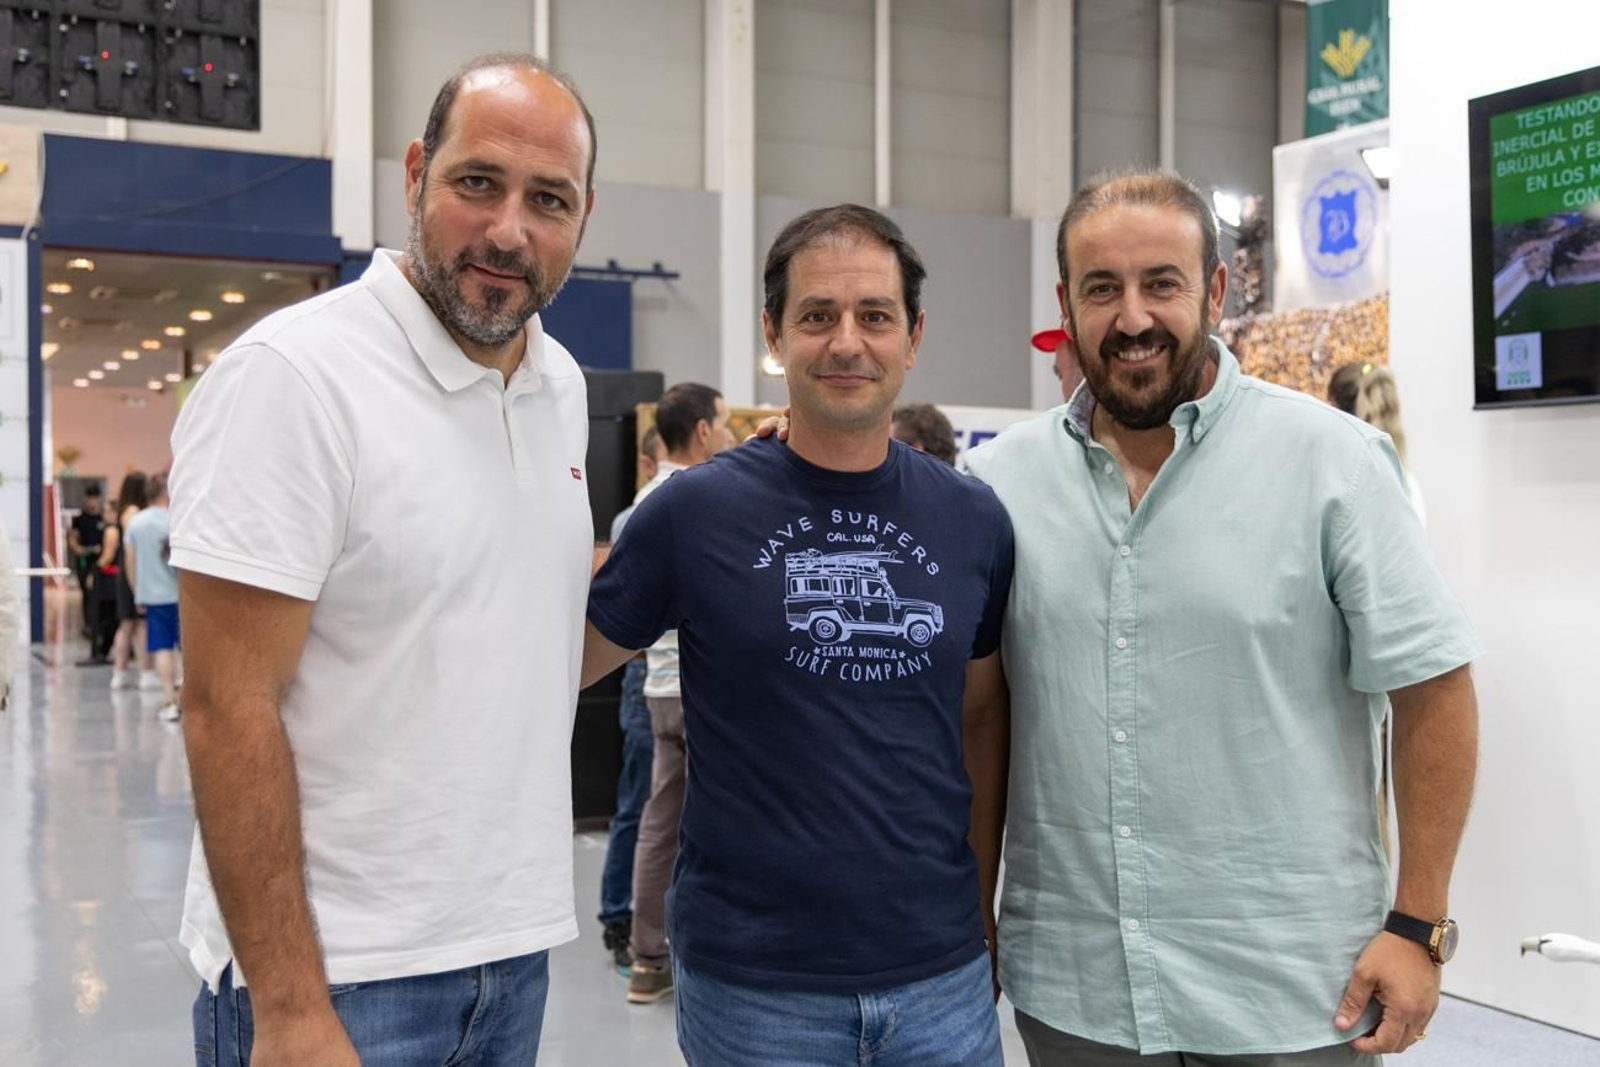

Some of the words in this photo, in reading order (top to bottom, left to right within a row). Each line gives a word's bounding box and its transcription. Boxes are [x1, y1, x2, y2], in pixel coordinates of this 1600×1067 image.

[1516, 96, 1600, 128] TESTANDO
[1493, 127, 1567, 157] INERCIAL
[1572, 119, 1595, 139] DE
[1496, 149, 1566, 177] BRÚJULA
[1570, 145, 1581, 161] Y
[1526, 174, 1547, 193] EN
[1552, 166, 1585, 187] LOS
[753, 516, 813, 569] WAVE
[831, 509, 939, 576] SURFERS
[854, 533, 876, 544] USA
[785, 646, 831, 675] SURF
[839, 651, 932, 682] COMPANY
[821, 646, 854, 657] SANTA
[859, 647, 897, 659] MONICA
